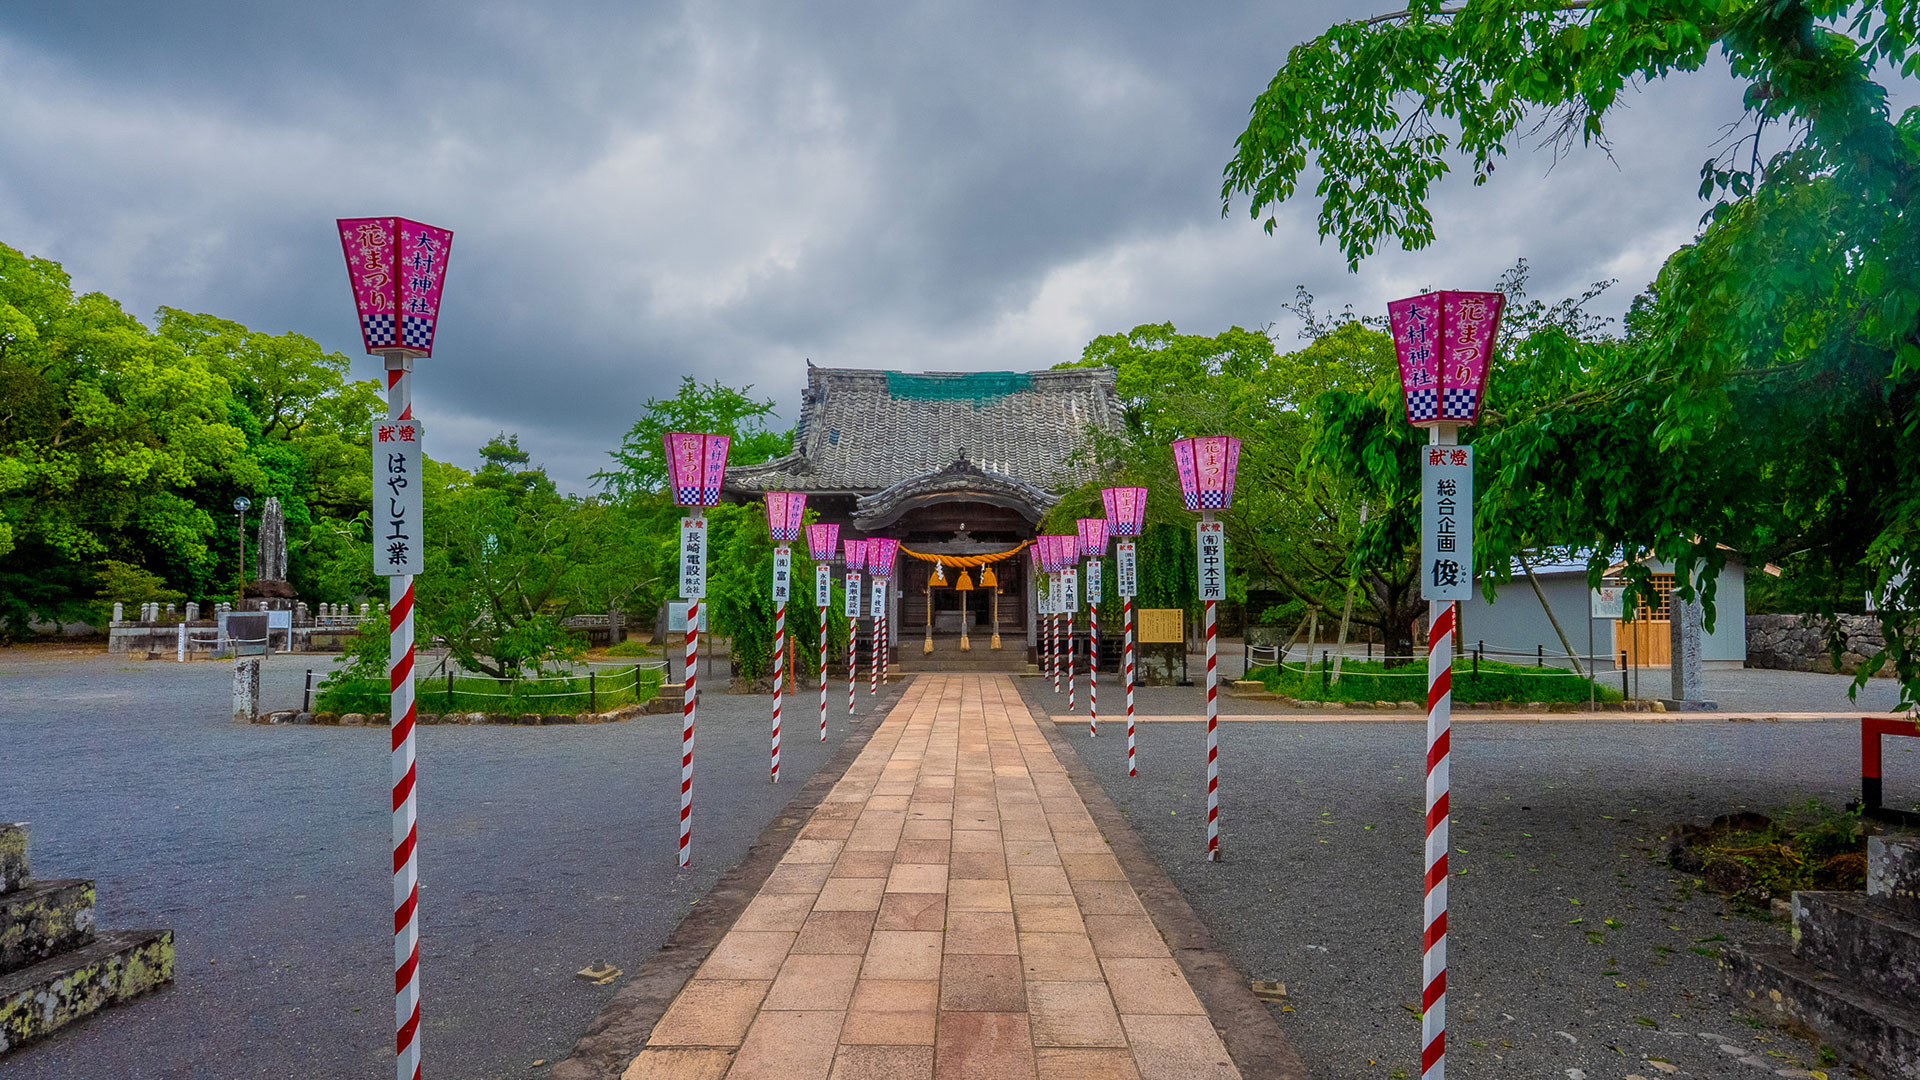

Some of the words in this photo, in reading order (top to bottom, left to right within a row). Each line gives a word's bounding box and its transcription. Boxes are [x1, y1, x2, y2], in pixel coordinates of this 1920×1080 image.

[357, 224, 388, 312] 花まつり
[409, 232, 435, 315] 大村神社
[1406, 304, 1432, 388] 大村神社
[1455, 299, 1485, 386] 花まつり
[378, 425, 416, 443] 献燈
[1429, 449, 1468, 466] 献燈
[682, 438, 697, 484] 花まつり
[709, 438, 721, 485] 大村神社
[1181, 445, 1193, 489] 大村神社
[1205, 440, 1220, 488] 花まつり
[386, 453, 409, 565] はやし工業
